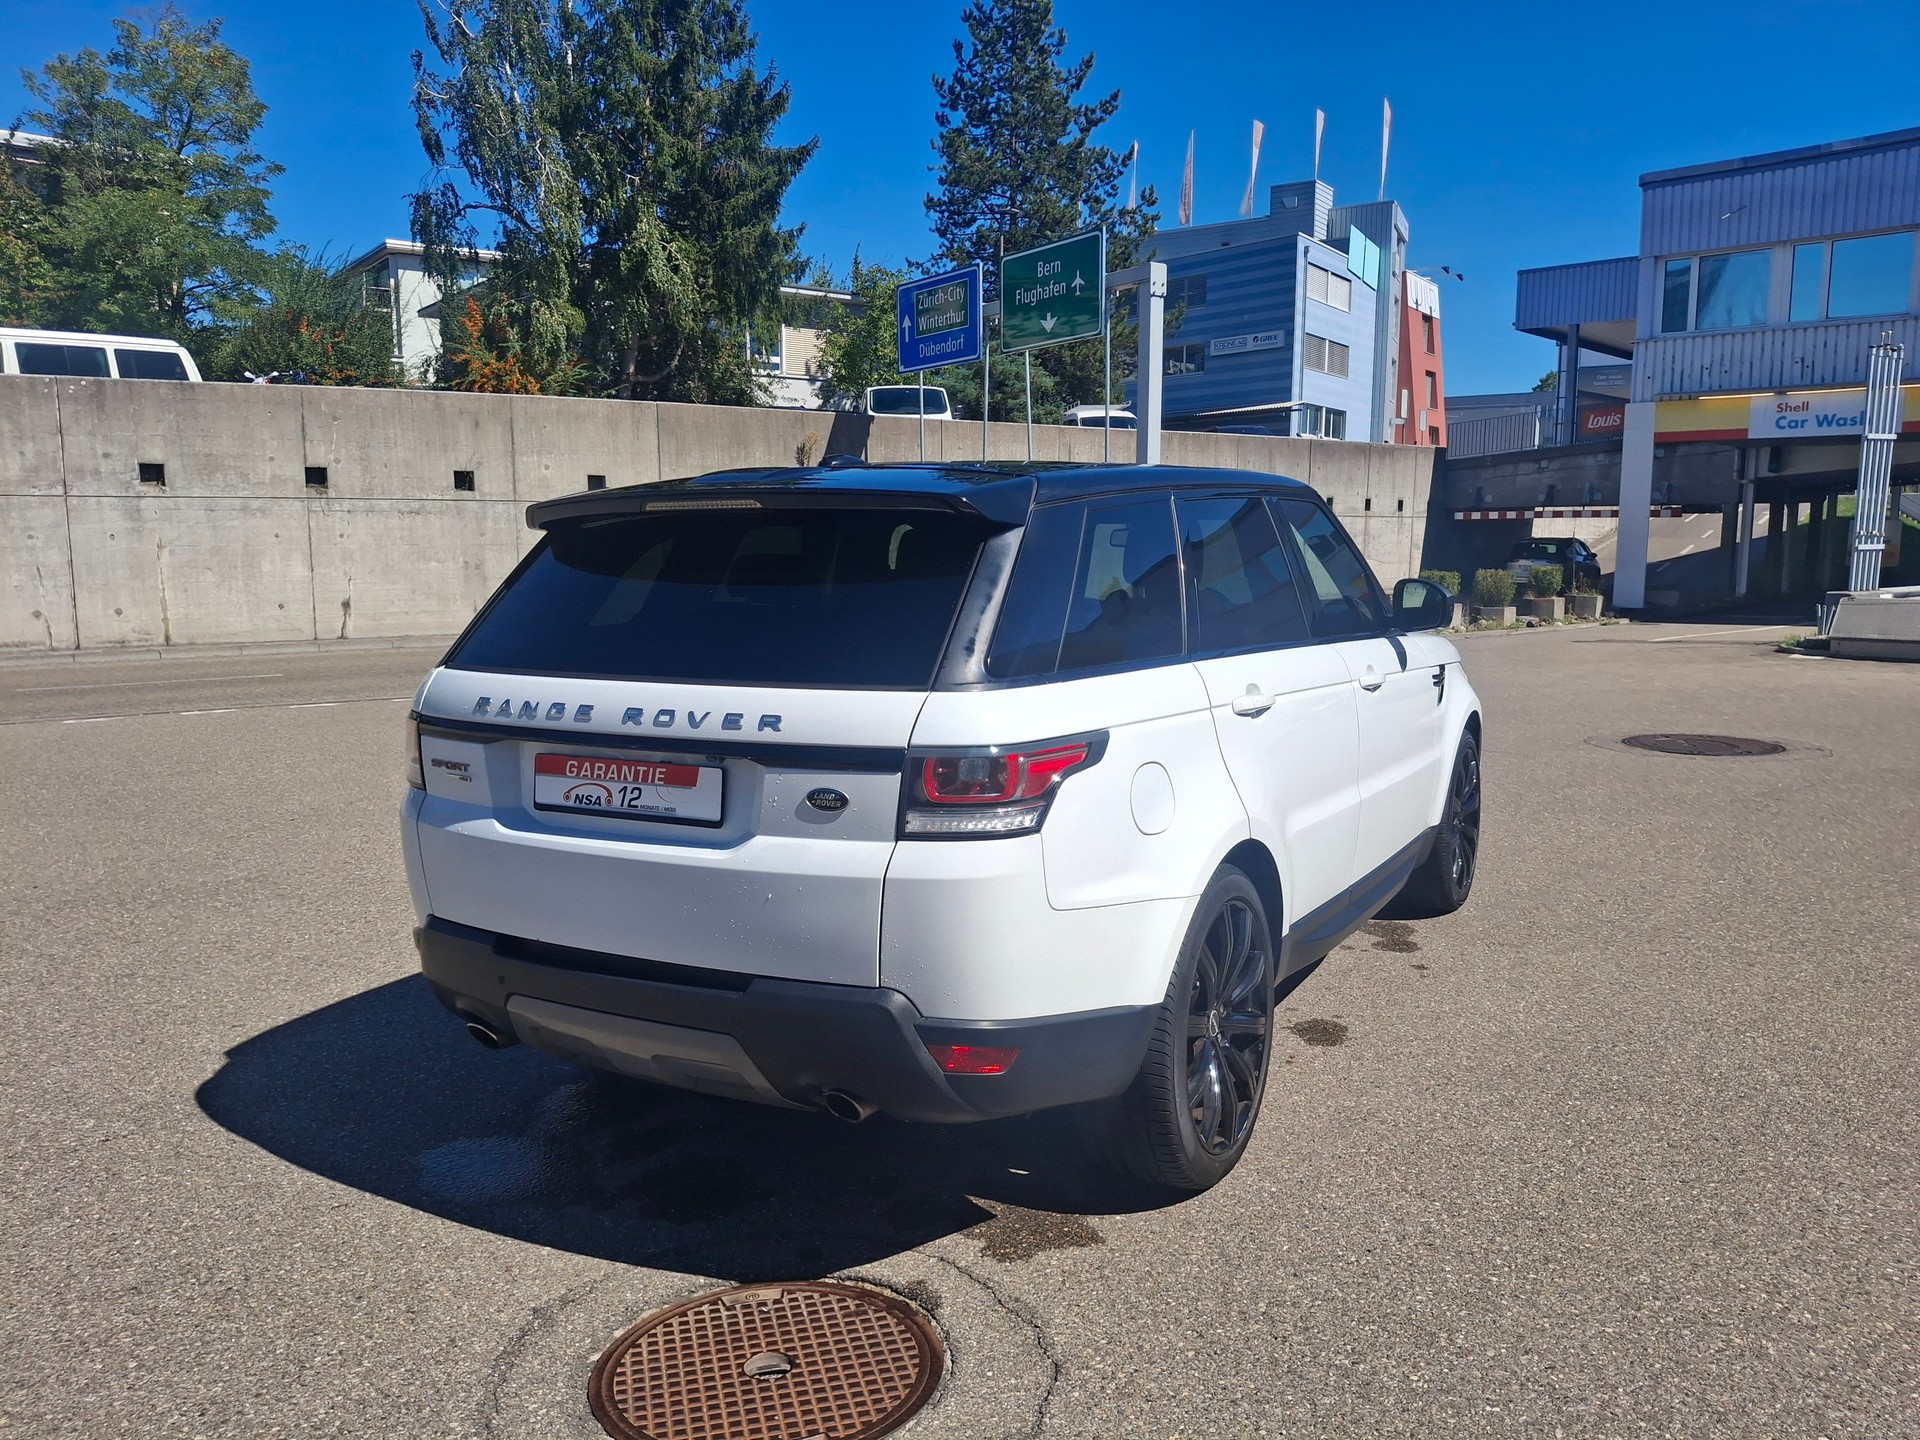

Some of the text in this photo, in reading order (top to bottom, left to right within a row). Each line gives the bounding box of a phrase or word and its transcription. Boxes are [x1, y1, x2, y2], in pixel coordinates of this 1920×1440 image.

[1037, 260, 1061, 278] Bern
[918, 286, 965, 309] Zürich-City
[1015, 280, 1066, 306] Flughafen
[918, 308, 966, 331] Winterthur
[919, 335, 965, 358] Dübendorf
[1776, 401, 1809, 413] Shell
[1587, 412, 1621, 429] Louis
[1775, 415, 1809, 430] Car
[472, 696, 783, 733] RANGE ROVER
[431, 758, 471, 772] SPORT
[566, 760, 666, 784] GARANTIE
[573, 792, 602, 808] NSA
[617, 785, 643, 809] 12
[815, 799, 842, 807] ROVER
